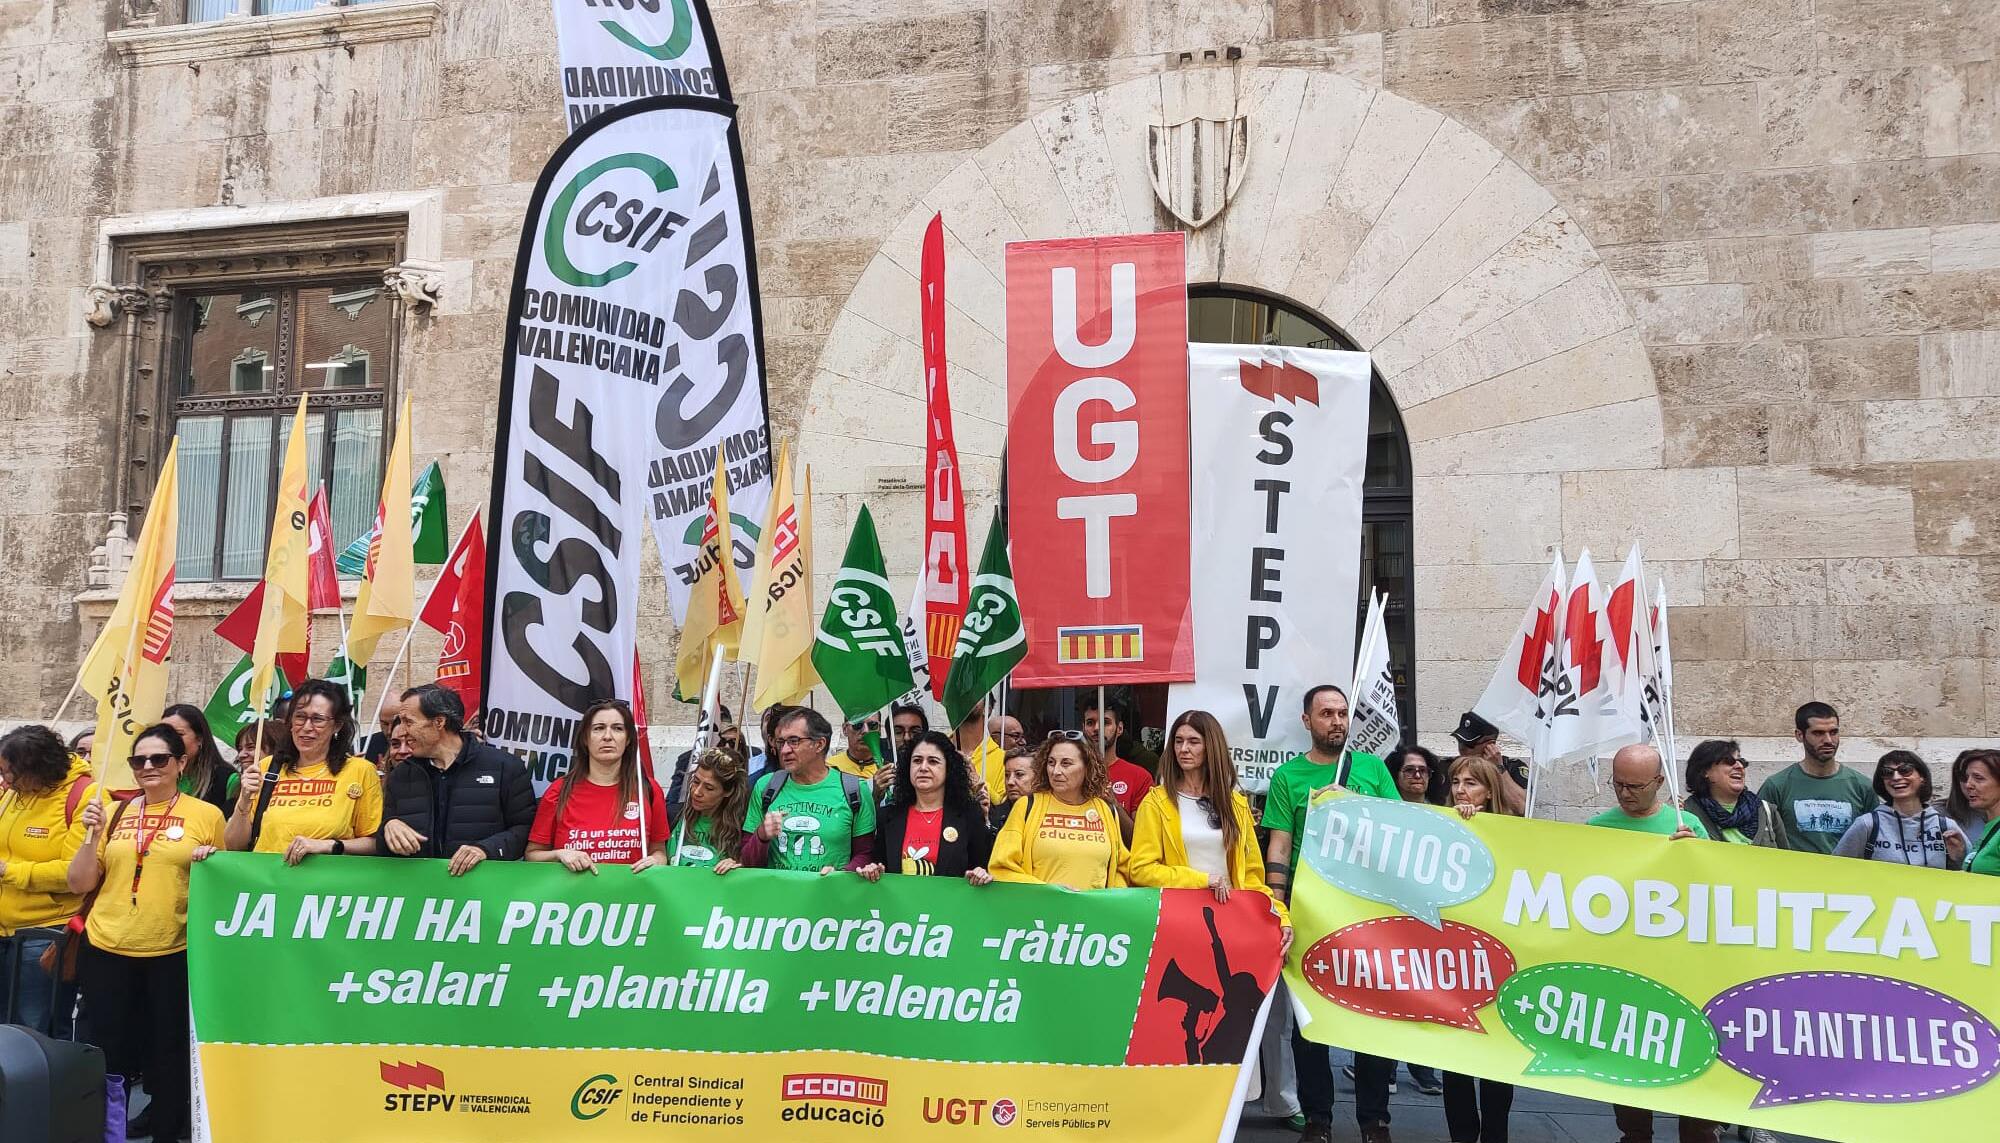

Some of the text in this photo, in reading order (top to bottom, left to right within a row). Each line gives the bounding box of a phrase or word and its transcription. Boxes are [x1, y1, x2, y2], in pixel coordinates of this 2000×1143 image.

[575, 190, 690, 253] CSIF
[520, 288, 667, 349] COMUNIDAD
[518, 324, 661, 386] VALENCIANA
[1051, 263, 1139, 599] UGT
[502, 363, 623, 714] CSIF
[1244, 410, 1295, 740] STEPV
[831, 587, 903, 657] CSIF
[275, 781, 314, 794] COO
[270, 795, 333, 808] ducació
[590, 829, 604, 838] un
[607, 827, 640, 837] servei
[1039, 829, 1106, 844] educació
[1875, 840, 1892, 849] NO
[590, 849, 632, 862] qualitat
[214, 892, 277, 938] JA
[414, 897, 482, 945] HA
[497, 900, 657, 947] PROU!
[683, 906, 954, 959] -burocràcia
[982, 920, 1132, 968] -ràtios
[1313, 940, 1495, 993] +VALENCIÀ
[327, 961, 1023, 1024] +salari +plantilla +valencià
[1513, 984, 1687, 1069] +SALARI
[1721, 1006, 1980, 1070] +PLANTILLES
[633, 1074, 744, 1090] Central Sindical
[786, 1078, 856, 1098] CCOO
[384, 1093, 456, 1112] STEPV
[459, 1094, 531, 1105] INTERSINDICAL
[581, 1087, 624, 1106] CSIF
[631, 1092, 744, 1110] Independiente y
[471, 1104, 531, 1114] VALENCIANA
[781, 1102, 885, 1128] educació
[921, 1096, 988, 1126] UGT
[1026, 1099, 1110, 1114] Ensenyament
[630, 1111, 744, 1125] de Funcionarios
[1025, 1117, 1111, 1130] Serveis Públics PV
